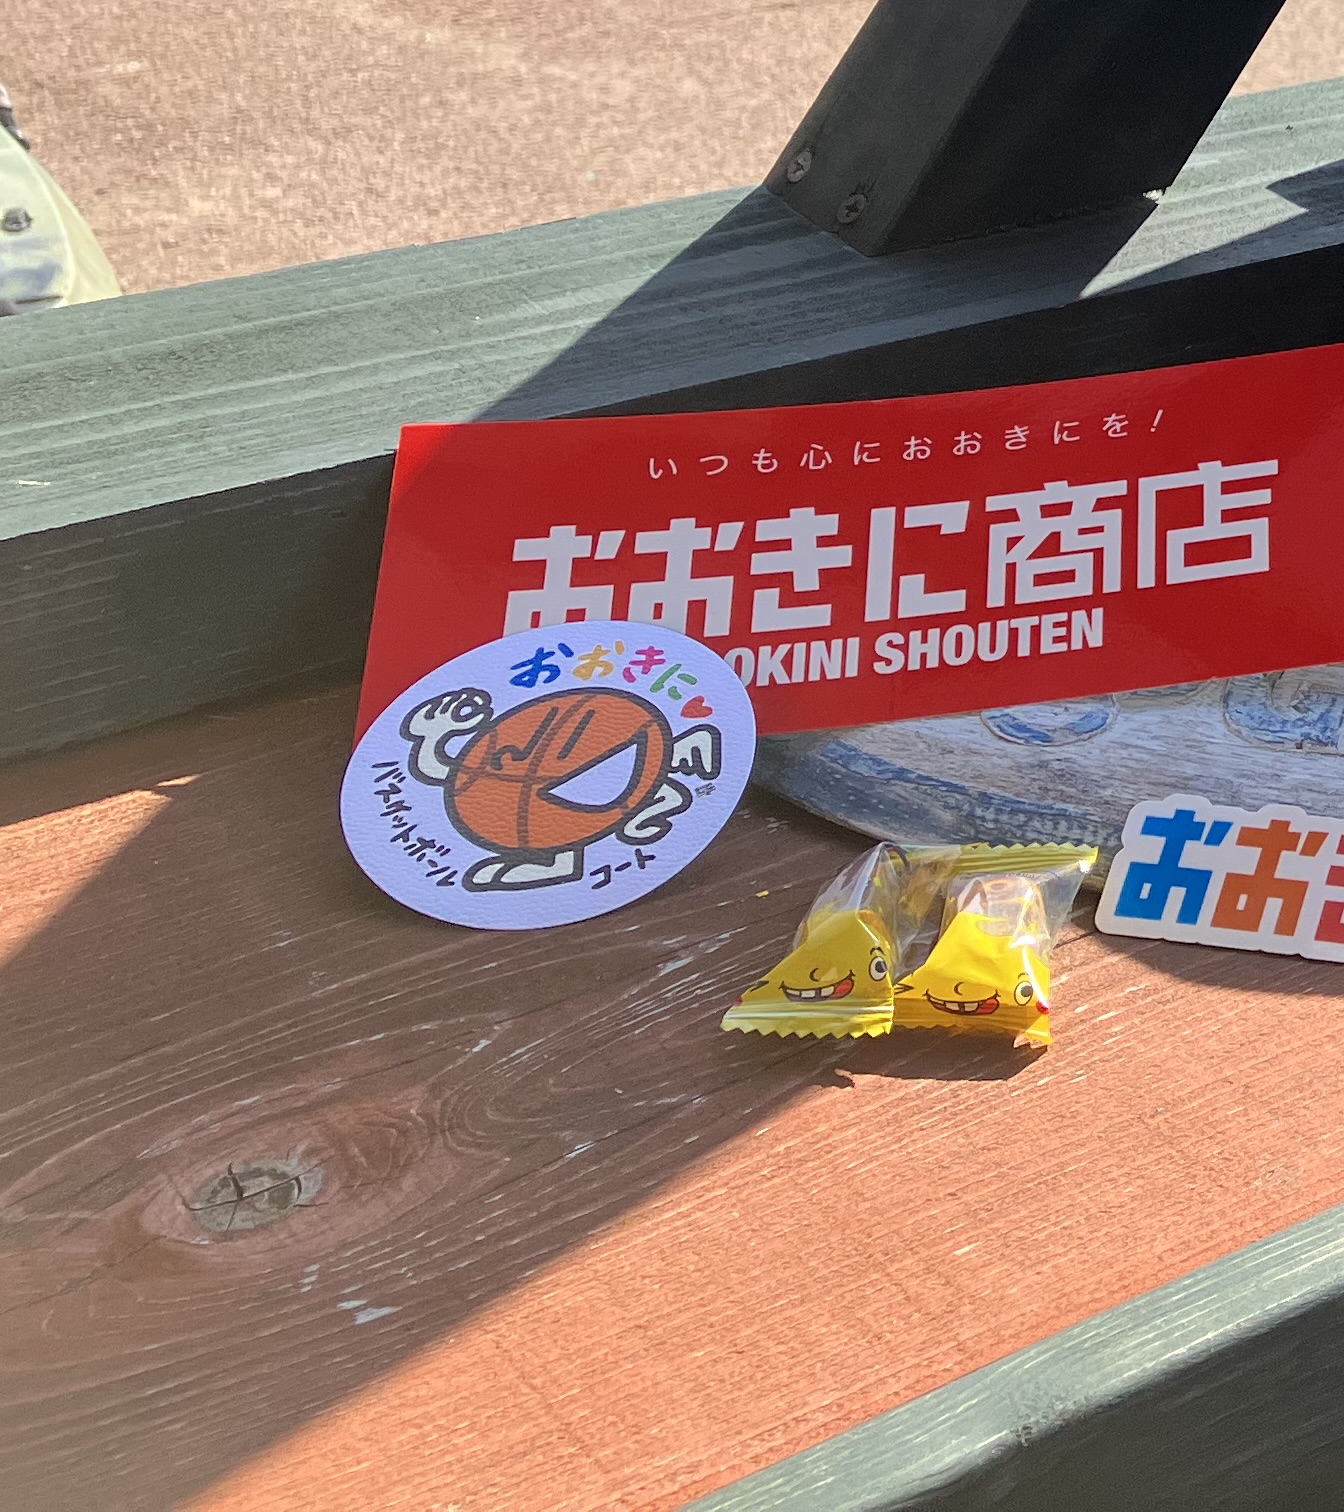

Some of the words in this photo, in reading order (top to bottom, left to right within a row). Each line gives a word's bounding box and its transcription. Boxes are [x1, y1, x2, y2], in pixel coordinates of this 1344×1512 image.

[648, 408, 1164, 481] いつも心におおきにを！
[502, 459, 1279, 638] おおきに商店
[510, 642, 698, 699] おおきに
[724, 636, 861, 688] OKINI
[872, 607, 1104, 676] SHOUTEN
[371, 760, 458, 888] バスケットボール
[589, 849, 657, 890] コート
